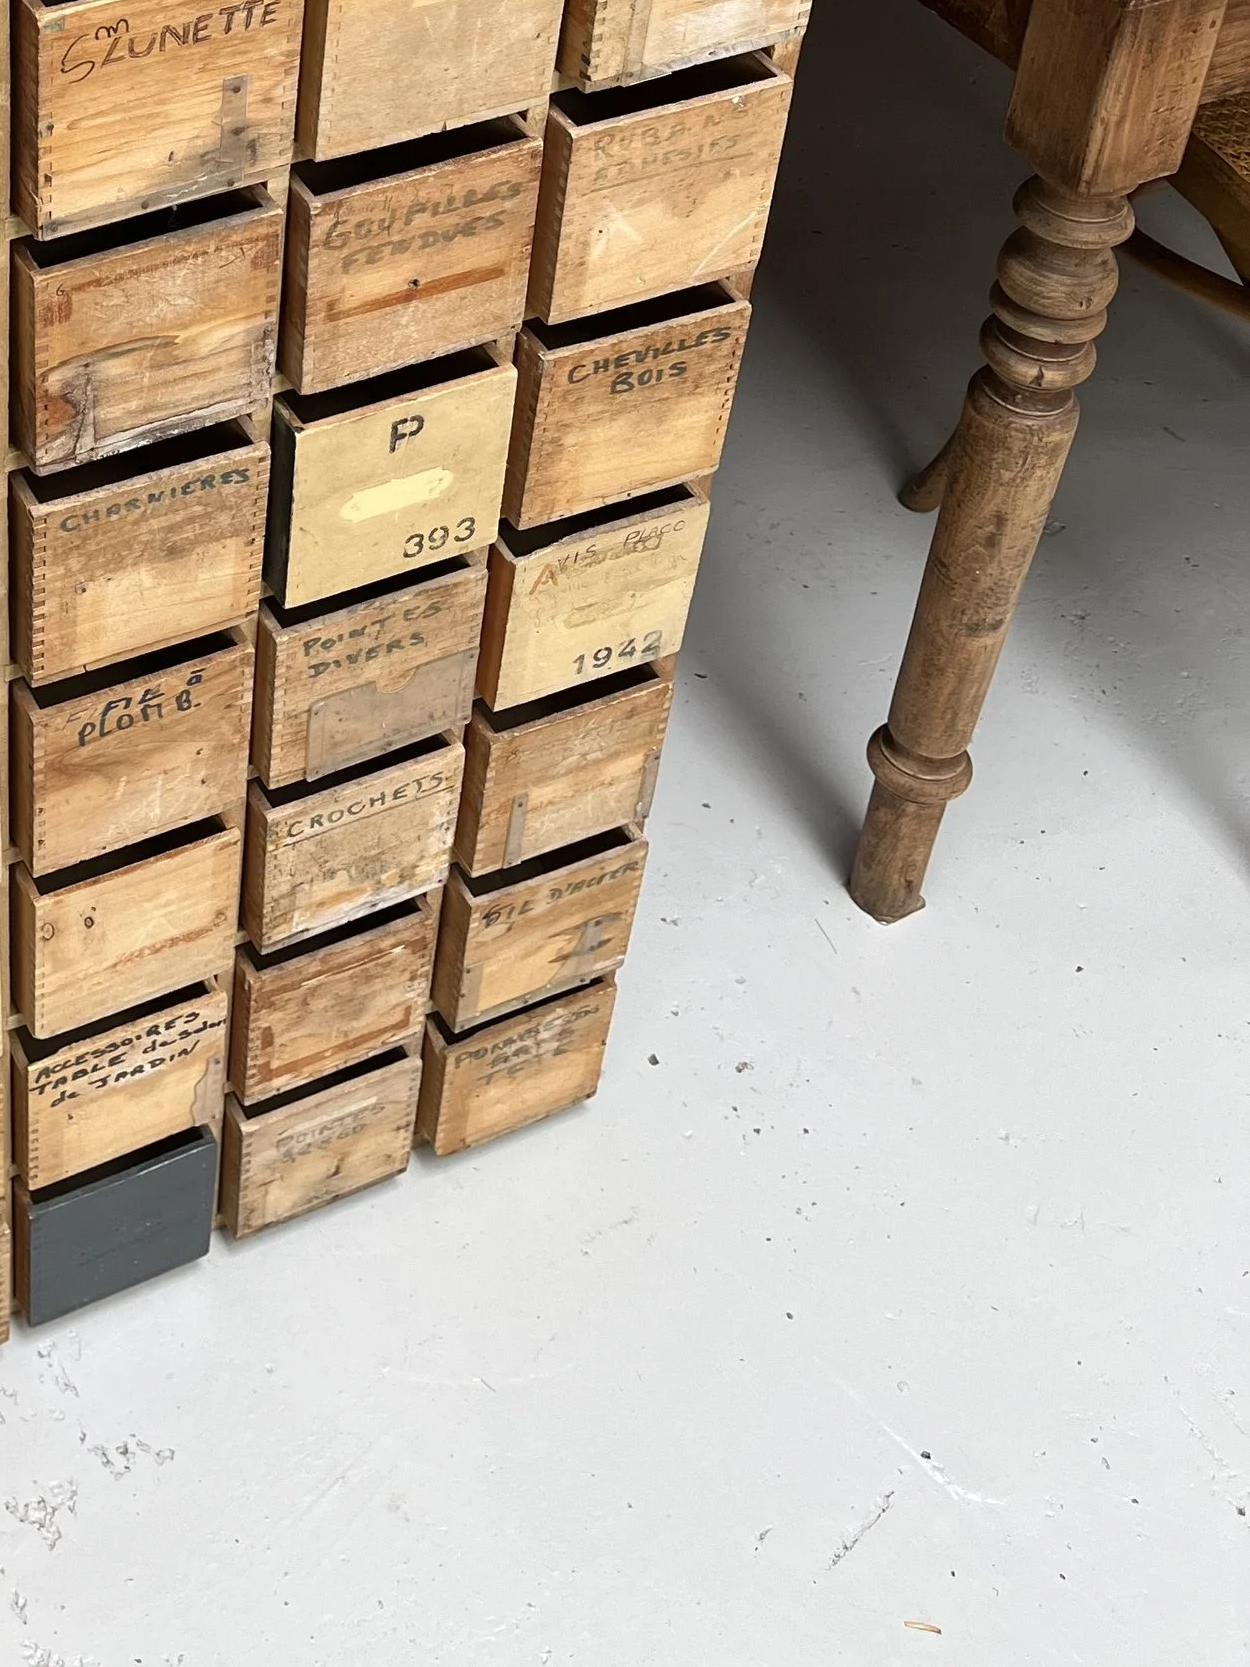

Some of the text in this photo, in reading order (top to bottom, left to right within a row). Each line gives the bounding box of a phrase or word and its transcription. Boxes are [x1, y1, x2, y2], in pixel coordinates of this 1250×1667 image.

[566, 326, 732, 384] CHEVILLES
[609, 361, 687, 395] BOIS
[388, 414, 425, 453] P
[60, 467, 250, 533] CHARNIERES
[402, 516, 477, 559] 393
[302, 601, 442, 658] POINTES
[308, 631, 426, 679] DIVERS
[286, 771, 444, 838] CROCHETS
[28, 1051, 128, 1096] TABLE
[49, 1038, 201, 1108] de JARDIN
